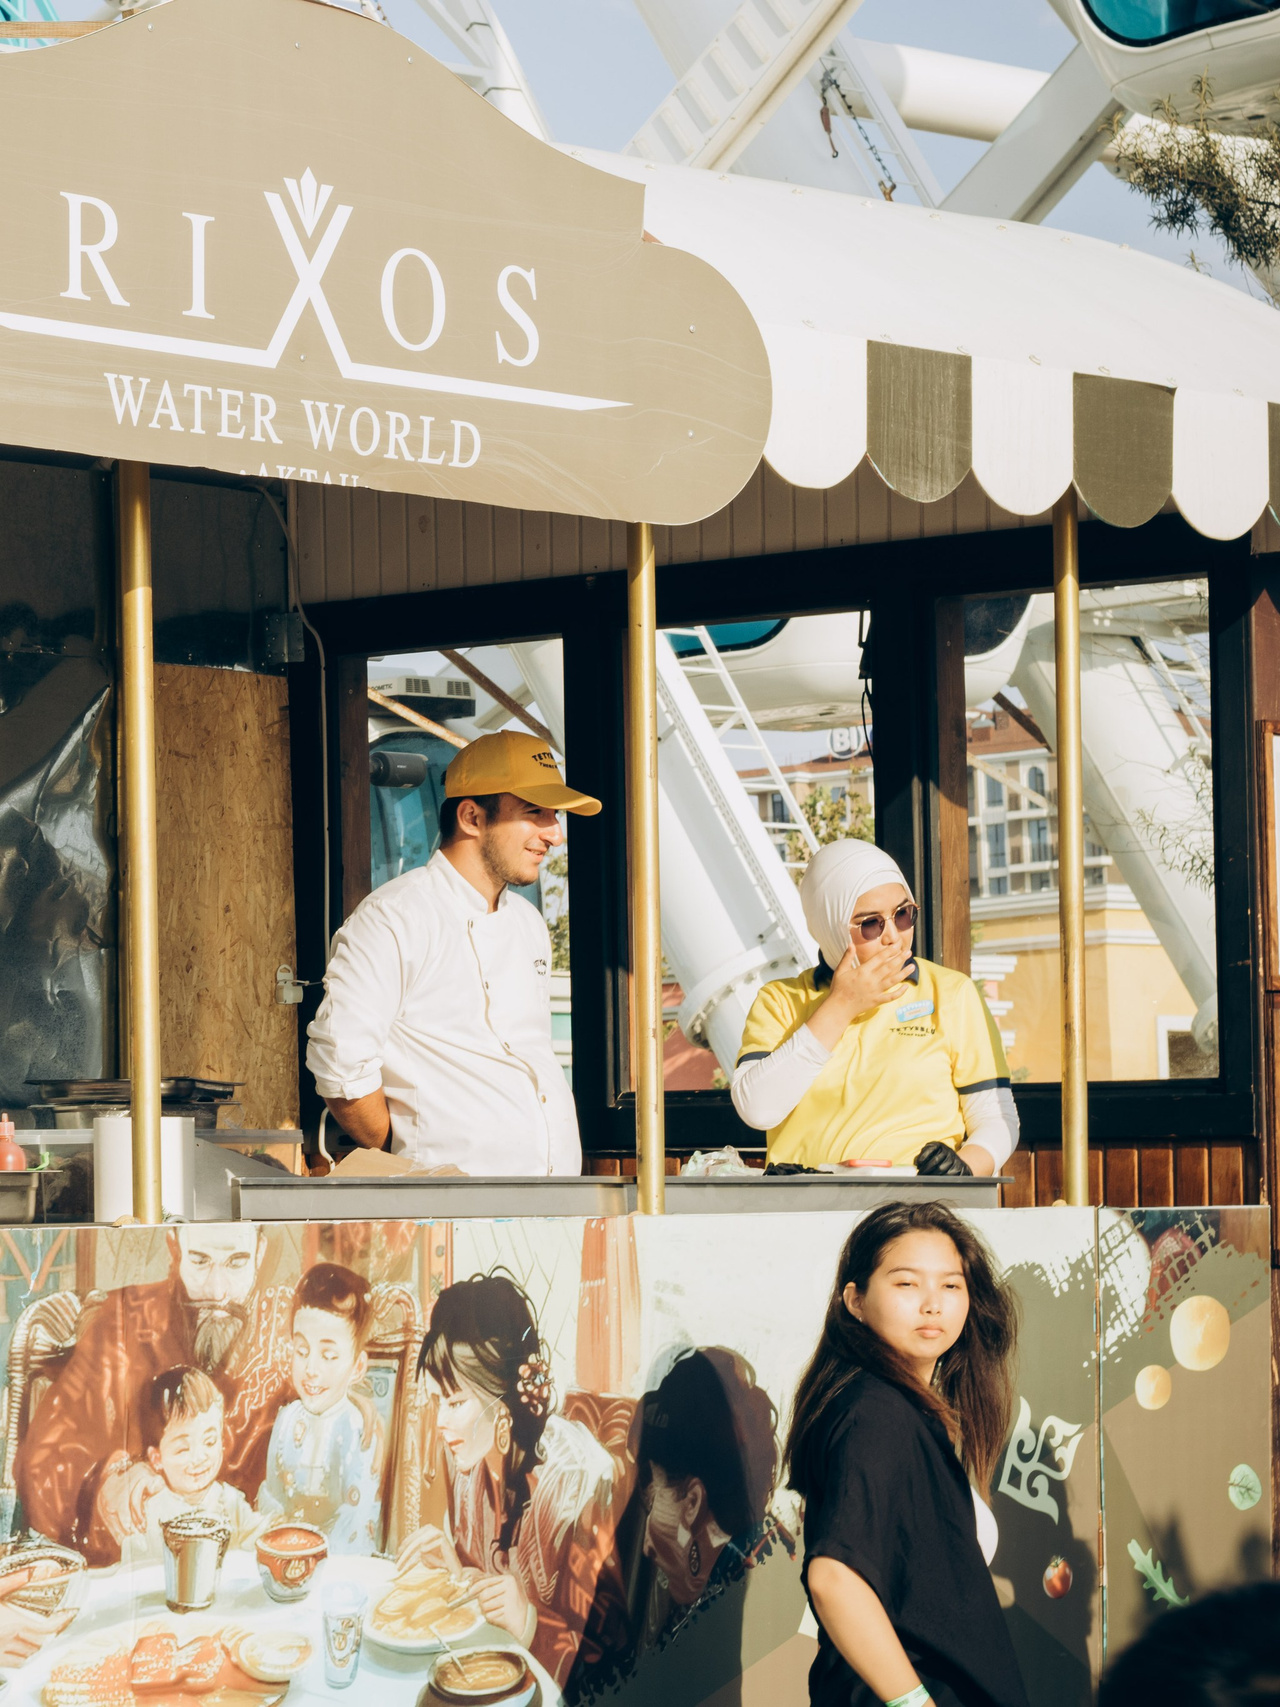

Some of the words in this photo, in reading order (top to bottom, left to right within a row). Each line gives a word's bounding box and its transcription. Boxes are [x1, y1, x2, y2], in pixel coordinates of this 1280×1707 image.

[60, 188, 540, 379] RIXOS
[104, 372, 283, 444] WATER
[300, 399, 482, 468] WORLD
